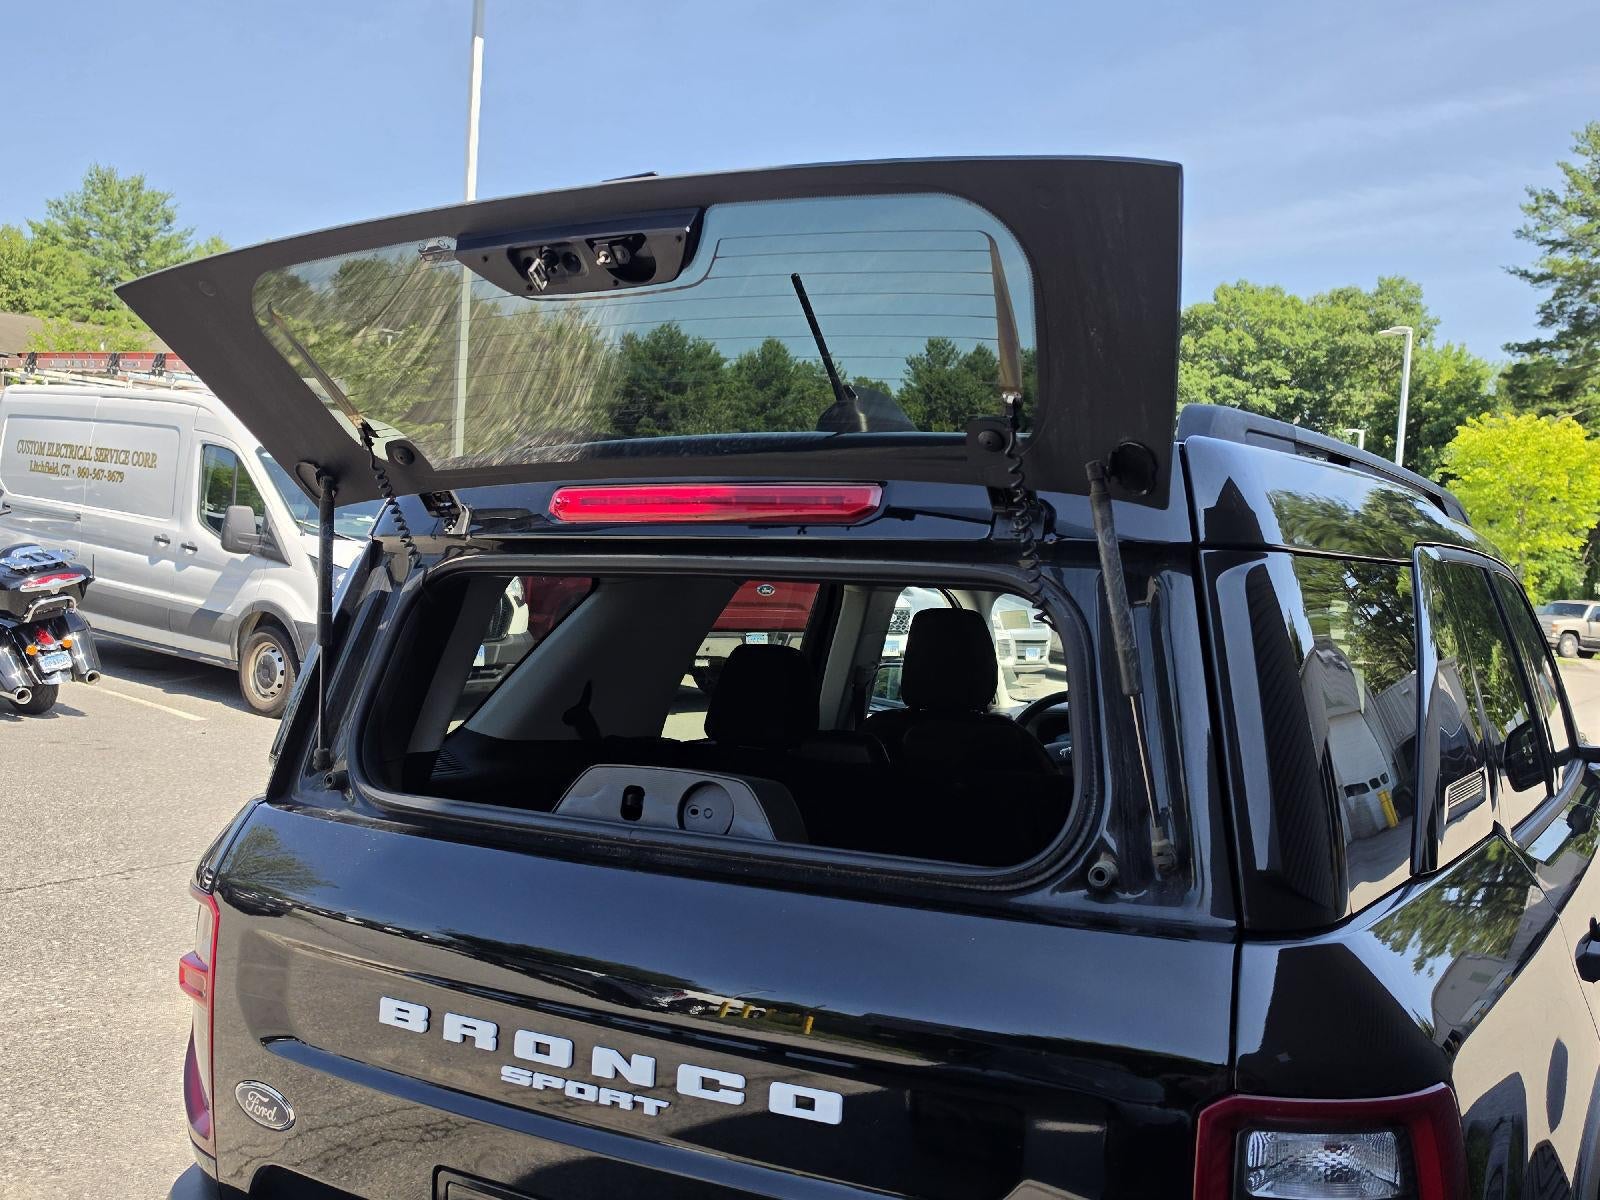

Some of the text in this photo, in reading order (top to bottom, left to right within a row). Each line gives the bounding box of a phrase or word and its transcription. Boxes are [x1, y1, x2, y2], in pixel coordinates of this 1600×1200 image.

[17, 439, 157, 468] CUSTOM ELECTRICAL SERVICE CORP.
[29, 460, 60, 477] Litchfield,
[60, 464, 71, 476] CT
[378, 996, 843, 1125] BRONCO
[245, 1091, 278, 1121] Ford
[500, 1065, 670, 1117] SPORT
